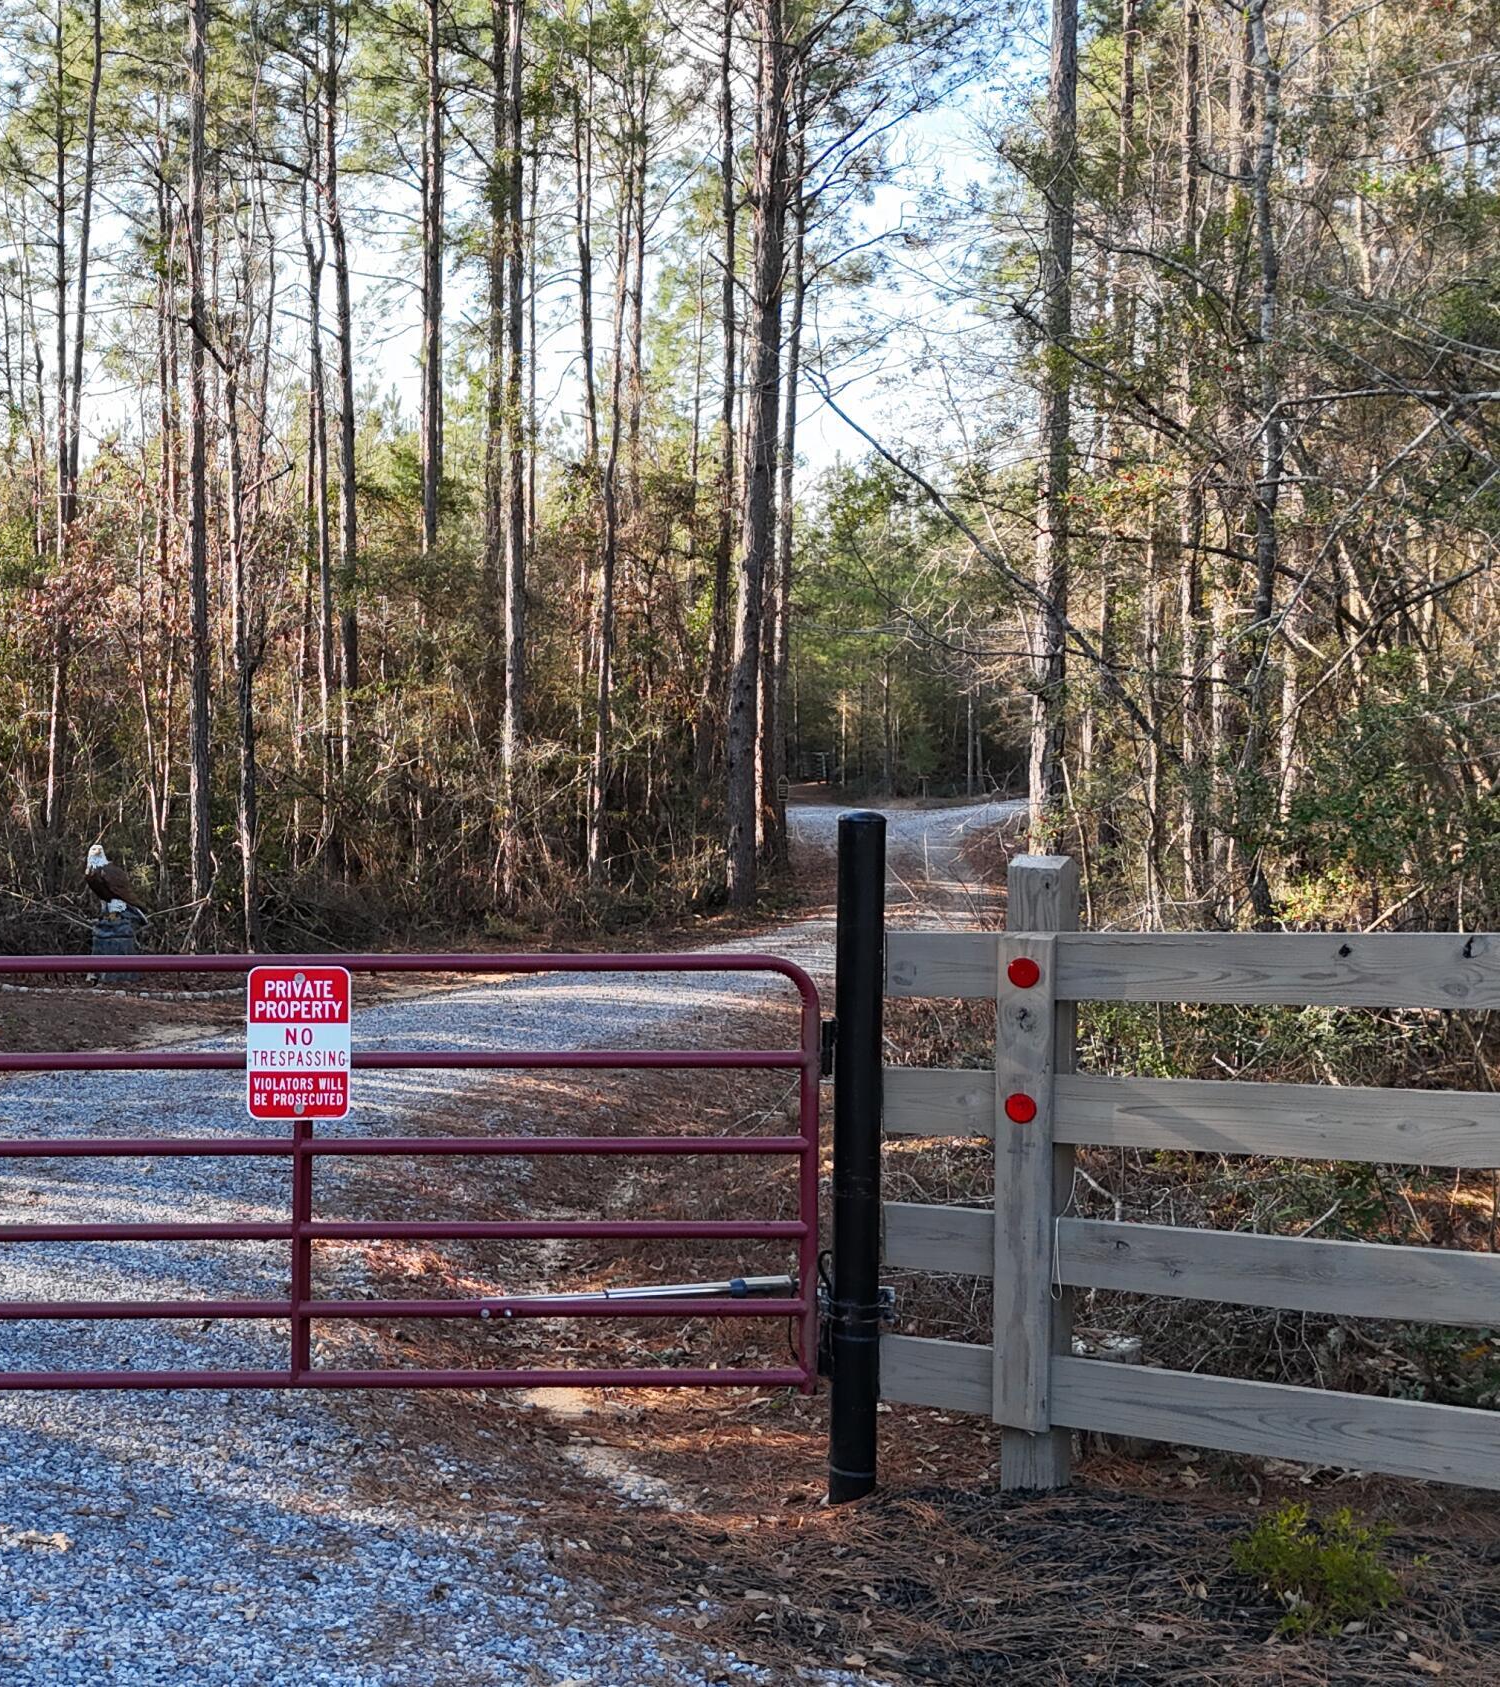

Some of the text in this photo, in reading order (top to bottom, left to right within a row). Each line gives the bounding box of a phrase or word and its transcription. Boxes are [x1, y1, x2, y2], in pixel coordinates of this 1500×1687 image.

[264, 980, 334, 998] PRIVATE
[255, 1001, 342, 1019] PROPERTY
[285, 1028, 313, 1046] NO
[252, 1050, 346, 1066] TRESPASSING
[253, 1078, 344, 1090] VIOLATORS WILL
[253, 1093, 344, 1106] BE PROSECUTED
